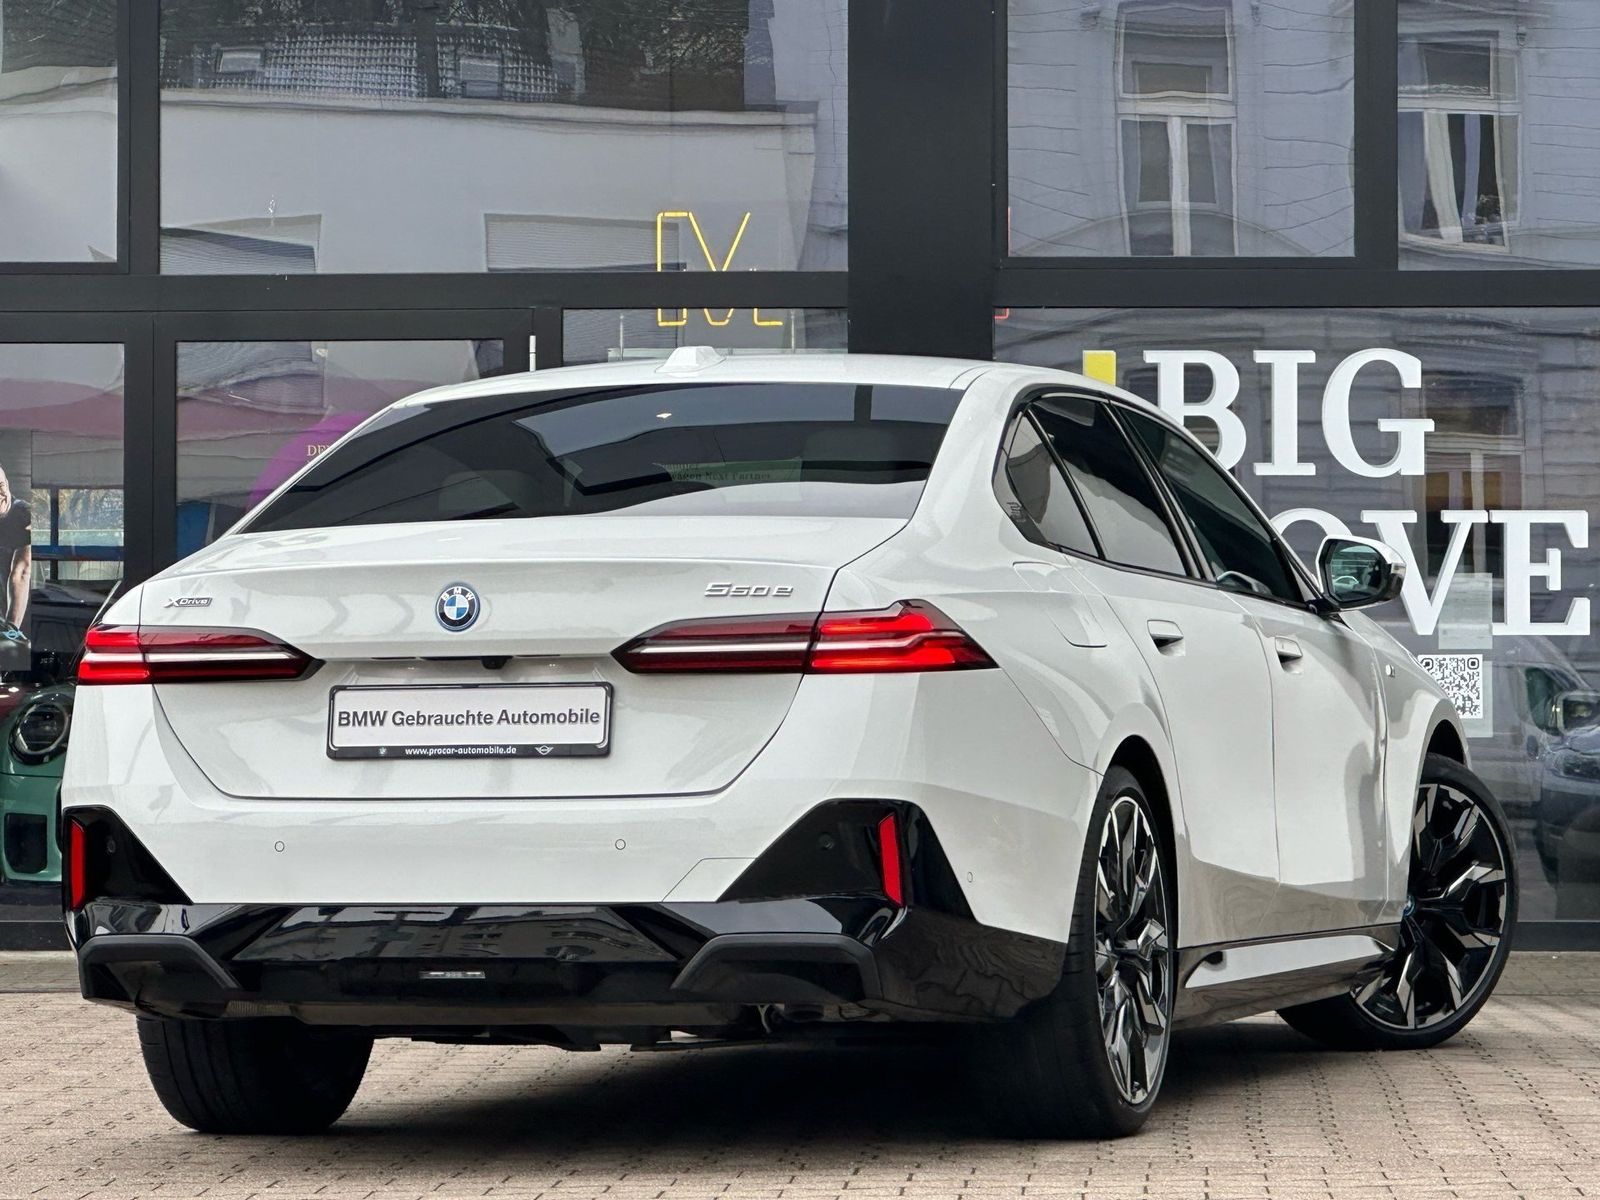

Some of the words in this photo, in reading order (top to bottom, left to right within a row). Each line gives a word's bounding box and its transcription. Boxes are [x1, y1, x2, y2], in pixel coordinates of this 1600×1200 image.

[1143, 347, 1435, 478] BIG
[440, 586, 476, 601] BMW
[338, 710, 388, 727] BMW
[391, 709, 494, 726] Gebrauchte
[497, 708, 600, 725] Automobile
[405, 746, 517, 756] www.procar-automobile.de
